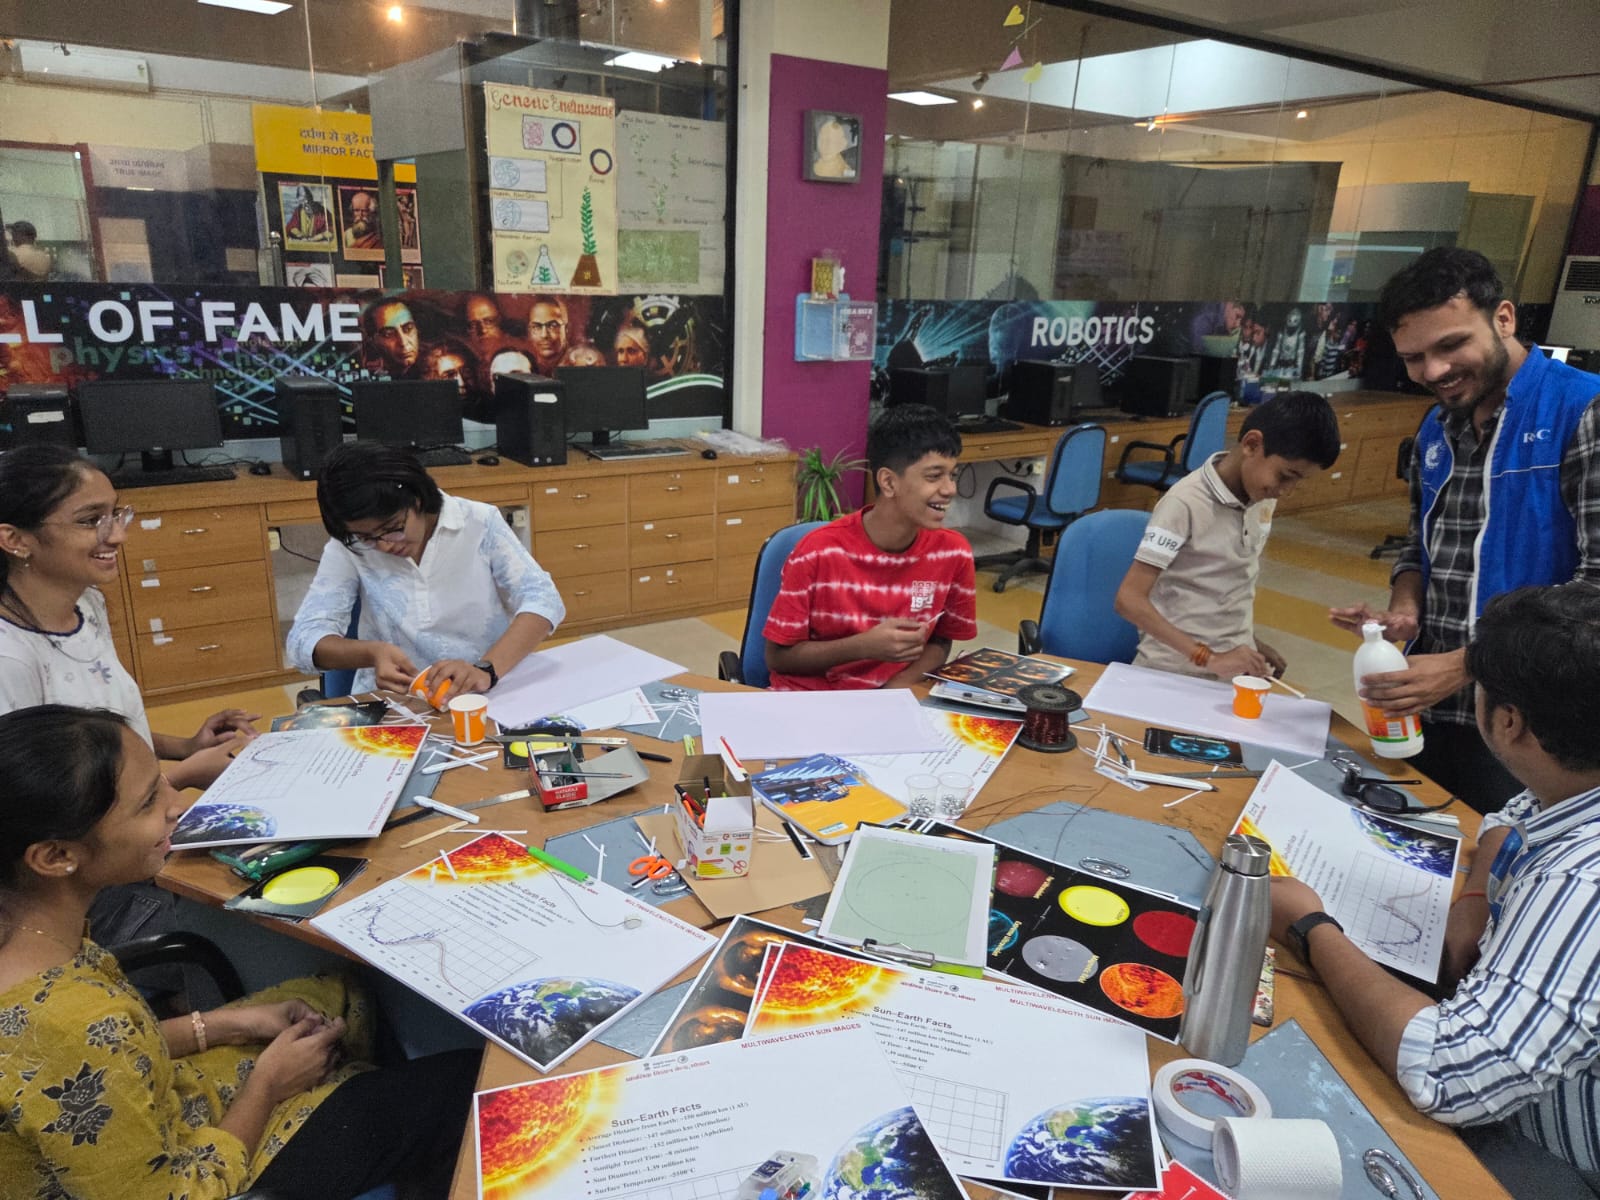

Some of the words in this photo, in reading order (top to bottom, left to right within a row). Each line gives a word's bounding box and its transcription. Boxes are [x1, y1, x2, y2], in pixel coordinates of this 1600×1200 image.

[302, 143, 346, 156] MIRROR
[88, 300, 175, 343] OF
[201, 302, 362, 343] FAME
[1031, 316, 1155, 346] ROBOTICS
[50, 336, 193, 373] physics
[1009, 998, 1083, 1018] MULTIWAVELENGTH
[926, 1018, 952, 1029] Facts
[741, 1030, 815, 1049] MULTIWAVELENGTH
[816, 1027, 832, 1036] SUN
[832, 1022, 862, 1033] IMAGES
[672, 1102, 702, 1115] Facts
